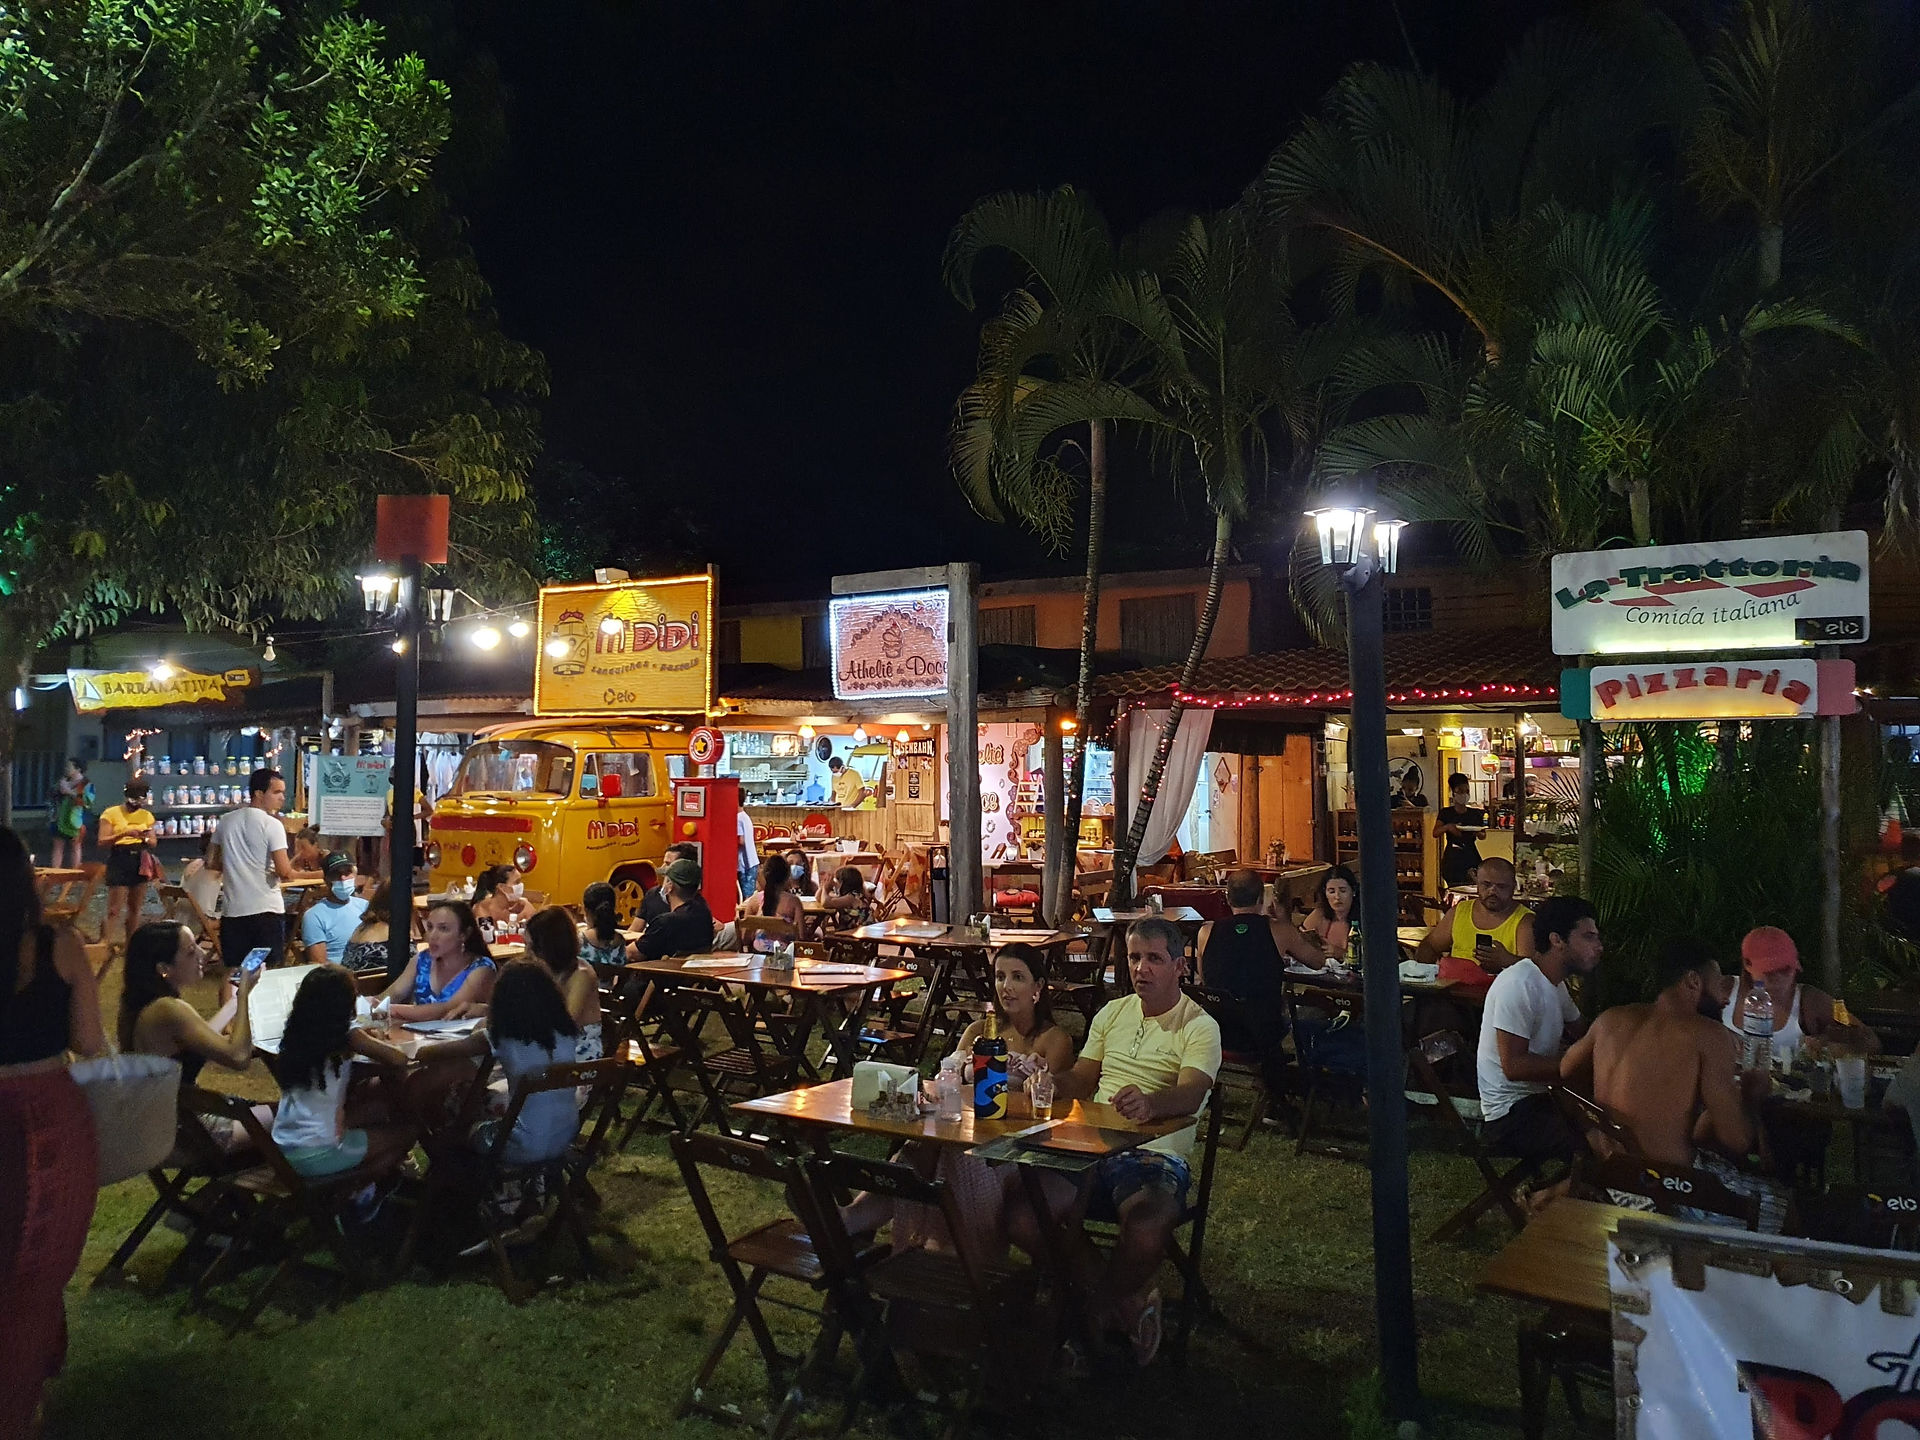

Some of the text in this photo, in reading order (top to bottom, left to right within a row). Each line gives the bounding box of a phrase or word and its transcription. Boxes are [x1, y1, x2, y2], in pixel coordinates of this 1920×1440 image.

[1554, 555, 1861, 609] La Trattoria
[1626, 593, 1801, 626] Comida italiana
[1825, 620, 1860, 635] elo
[839, 660, 893, 681] Atheliê
[1595, 666, 1811, 709] Pizzaria
[1335, 998, 1351, 1006] elo
[1663, 1176, 1693, 1194] elo
[1887, 1196, 1918, 1211] elo
